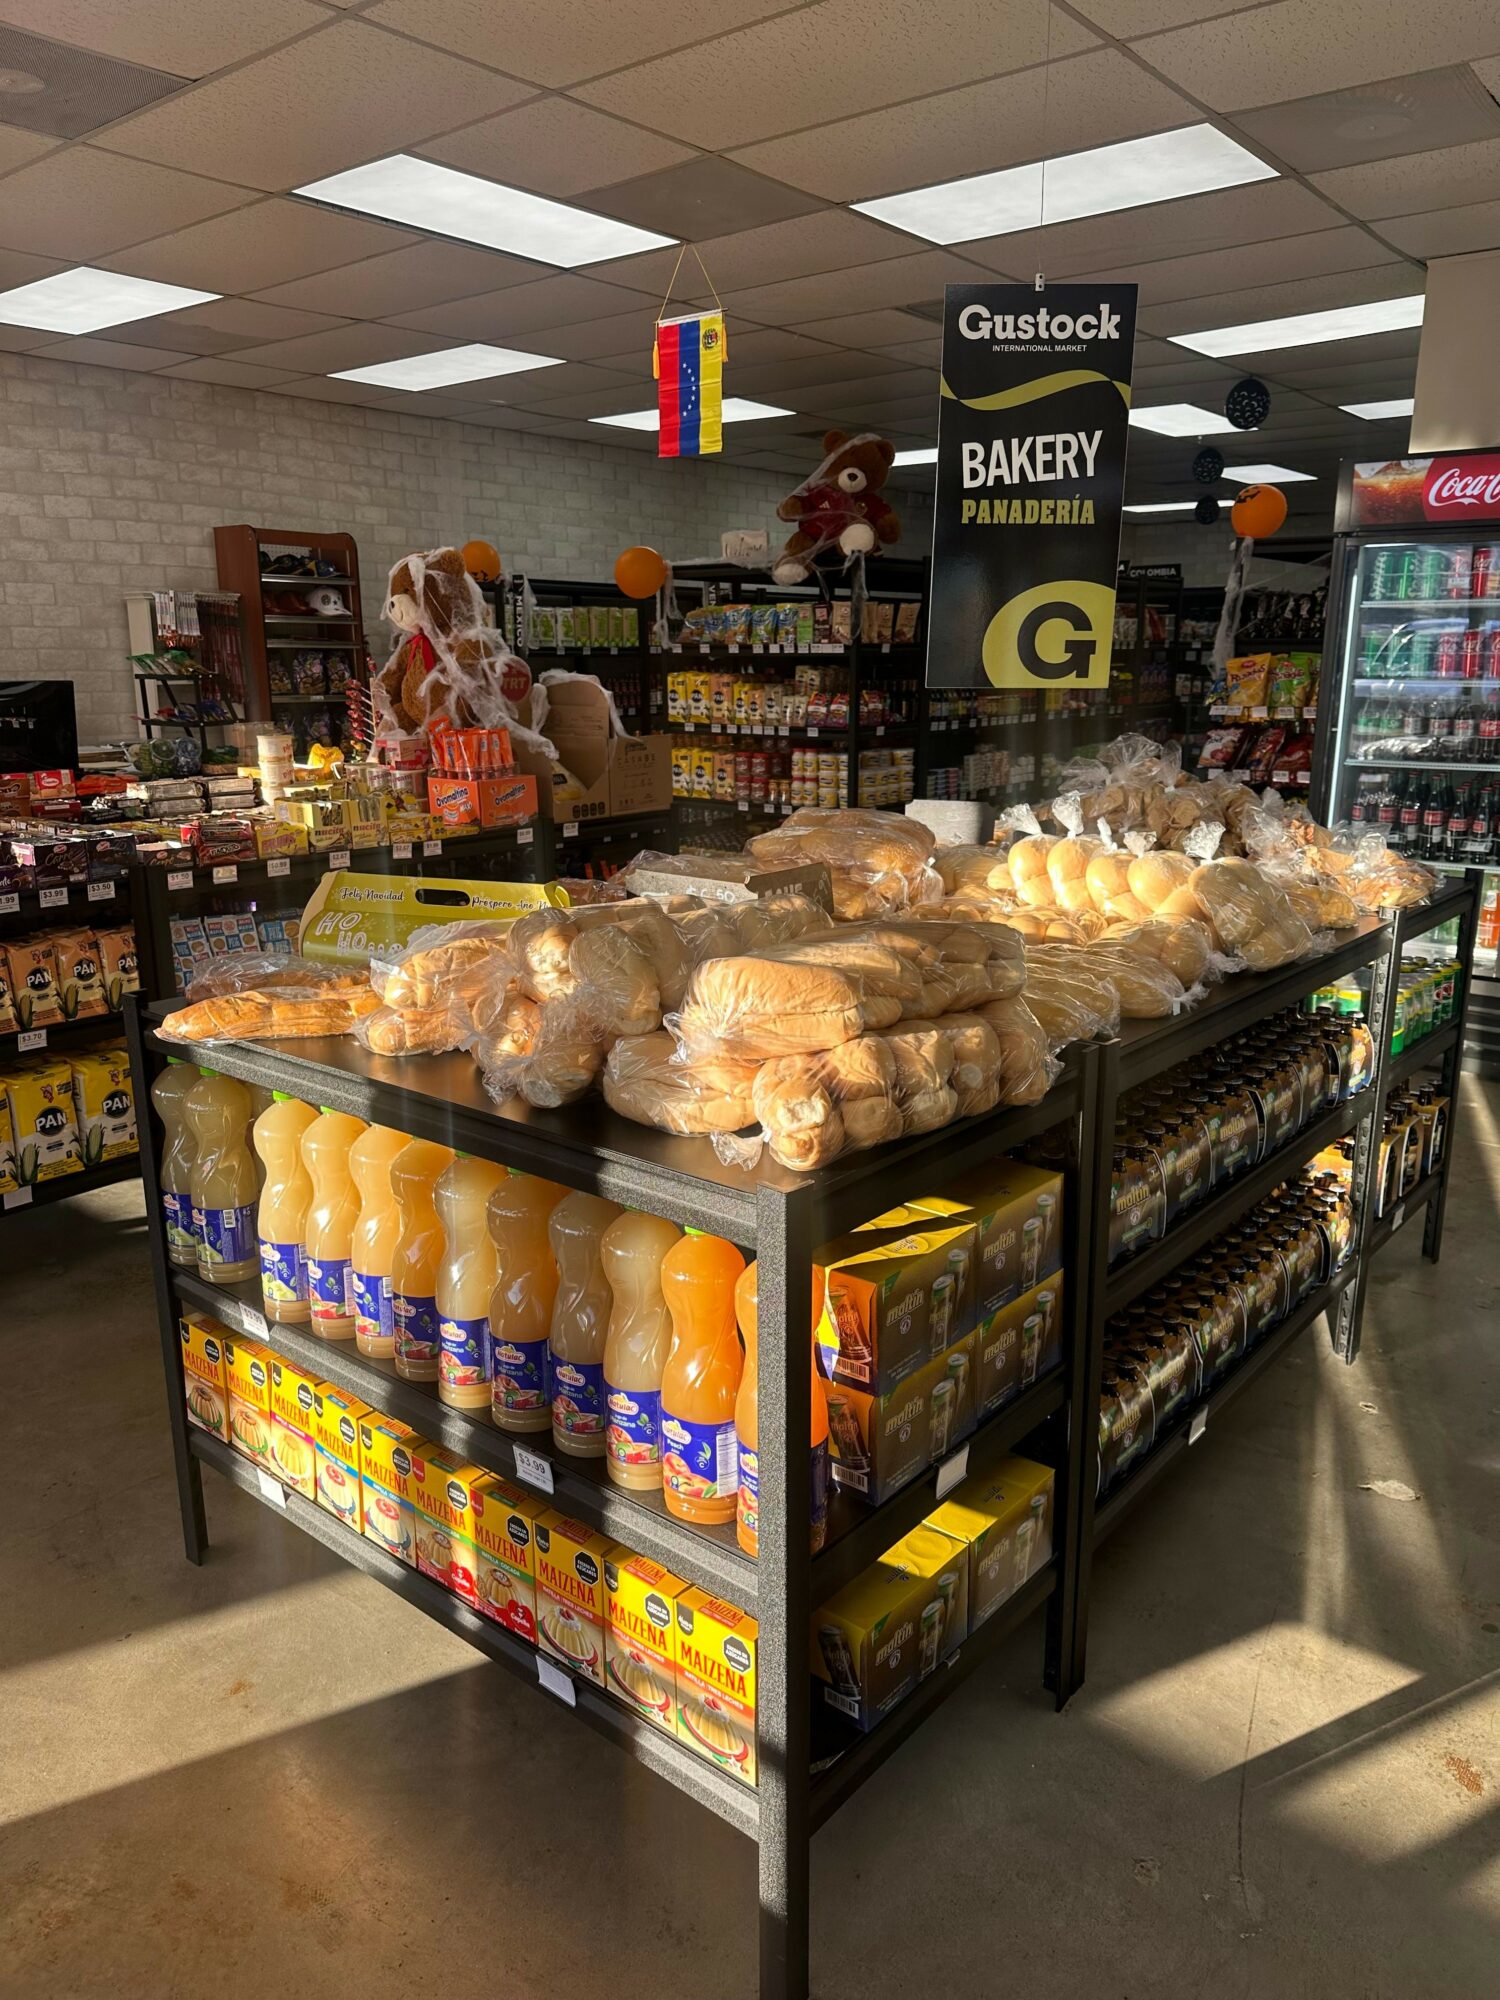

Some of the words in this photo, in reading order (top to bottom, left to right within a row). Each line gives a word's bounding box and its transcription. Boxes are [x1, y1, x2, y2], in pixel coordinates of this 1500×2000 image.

[958, 303, 1120, 340] Gustock
[992, 344, 1053, 353] INTERNATIONAL
[1054, 344, 1088, 353] MARKET
[962, 429, 1103, 489] BAKERY
[961, 494, 1096, 525] PANADERÍA
[515, 595, 525, 648] MEXICO
[1017, 601, 1097, 680] G
[42, 888, 64, 899] $3.99
[91, 882, 111, 892] $3.50
[340, 887, 363, 902] Feliz
[364, 889, 405, 901] Navidad
[316, 911, 362, 936] HO
[337, 931, 367, 956] HO
[26, 969, 53, 987] PAN
[73, 962, 98, 977] PAN
[102, 1095, 131, 1113] PAN
[35, 1112, 67, 1132] PAN
[184, 1348, 220, 1381] MAIZENA
[497, 1349, 523, 1362] Natulac
[228, 1370, 265, 1402] MAIZENA
[558, 1370, 583, 1385] Natulac
[273, 1391, 311, 1430] MAIZENA
[610, 1398, 636, 1412] Natulac
[316, 1422, 354, 1463] MAIZENA
[667, 1438, 685, 1451] Peach
[364, 1456, 409, 1497] MAIZENA
[518, 1452, 546, 1474] $3.99
[416, 1487, 466, 1530] MAIZENA
[474, 1522, 528, 1568] MAIZENA
[481, 1550, 499, 1565] NATILLA
[500, 1559, 521, 1576] COCADA
[631, 1557, 667, 1581] MAIZENA
[539, 1558, 596, 1609] MAIZENA
[542, 1586, 560, 1602] NATILLA
[562, 1598, 575, 1608] TRES
[574, 1603, 593, 1619] LECHES
[705, 1599, 745, 1624] MAIZENA
[608, 1598, 668, 1652] MAIZENA
[612, 1626, 630, 1642] NATILLA
[630, 1638, 644, 1651] TRES
[644, 1646, 665, 1663] LECHES
[680, 1641, 747, 1698] MAIZENA
[684, 1670, 705, 1688] NATILLA
[706, 1686, 722, 1698] TRES
[721, 1692, 744, 1711] LECHES
